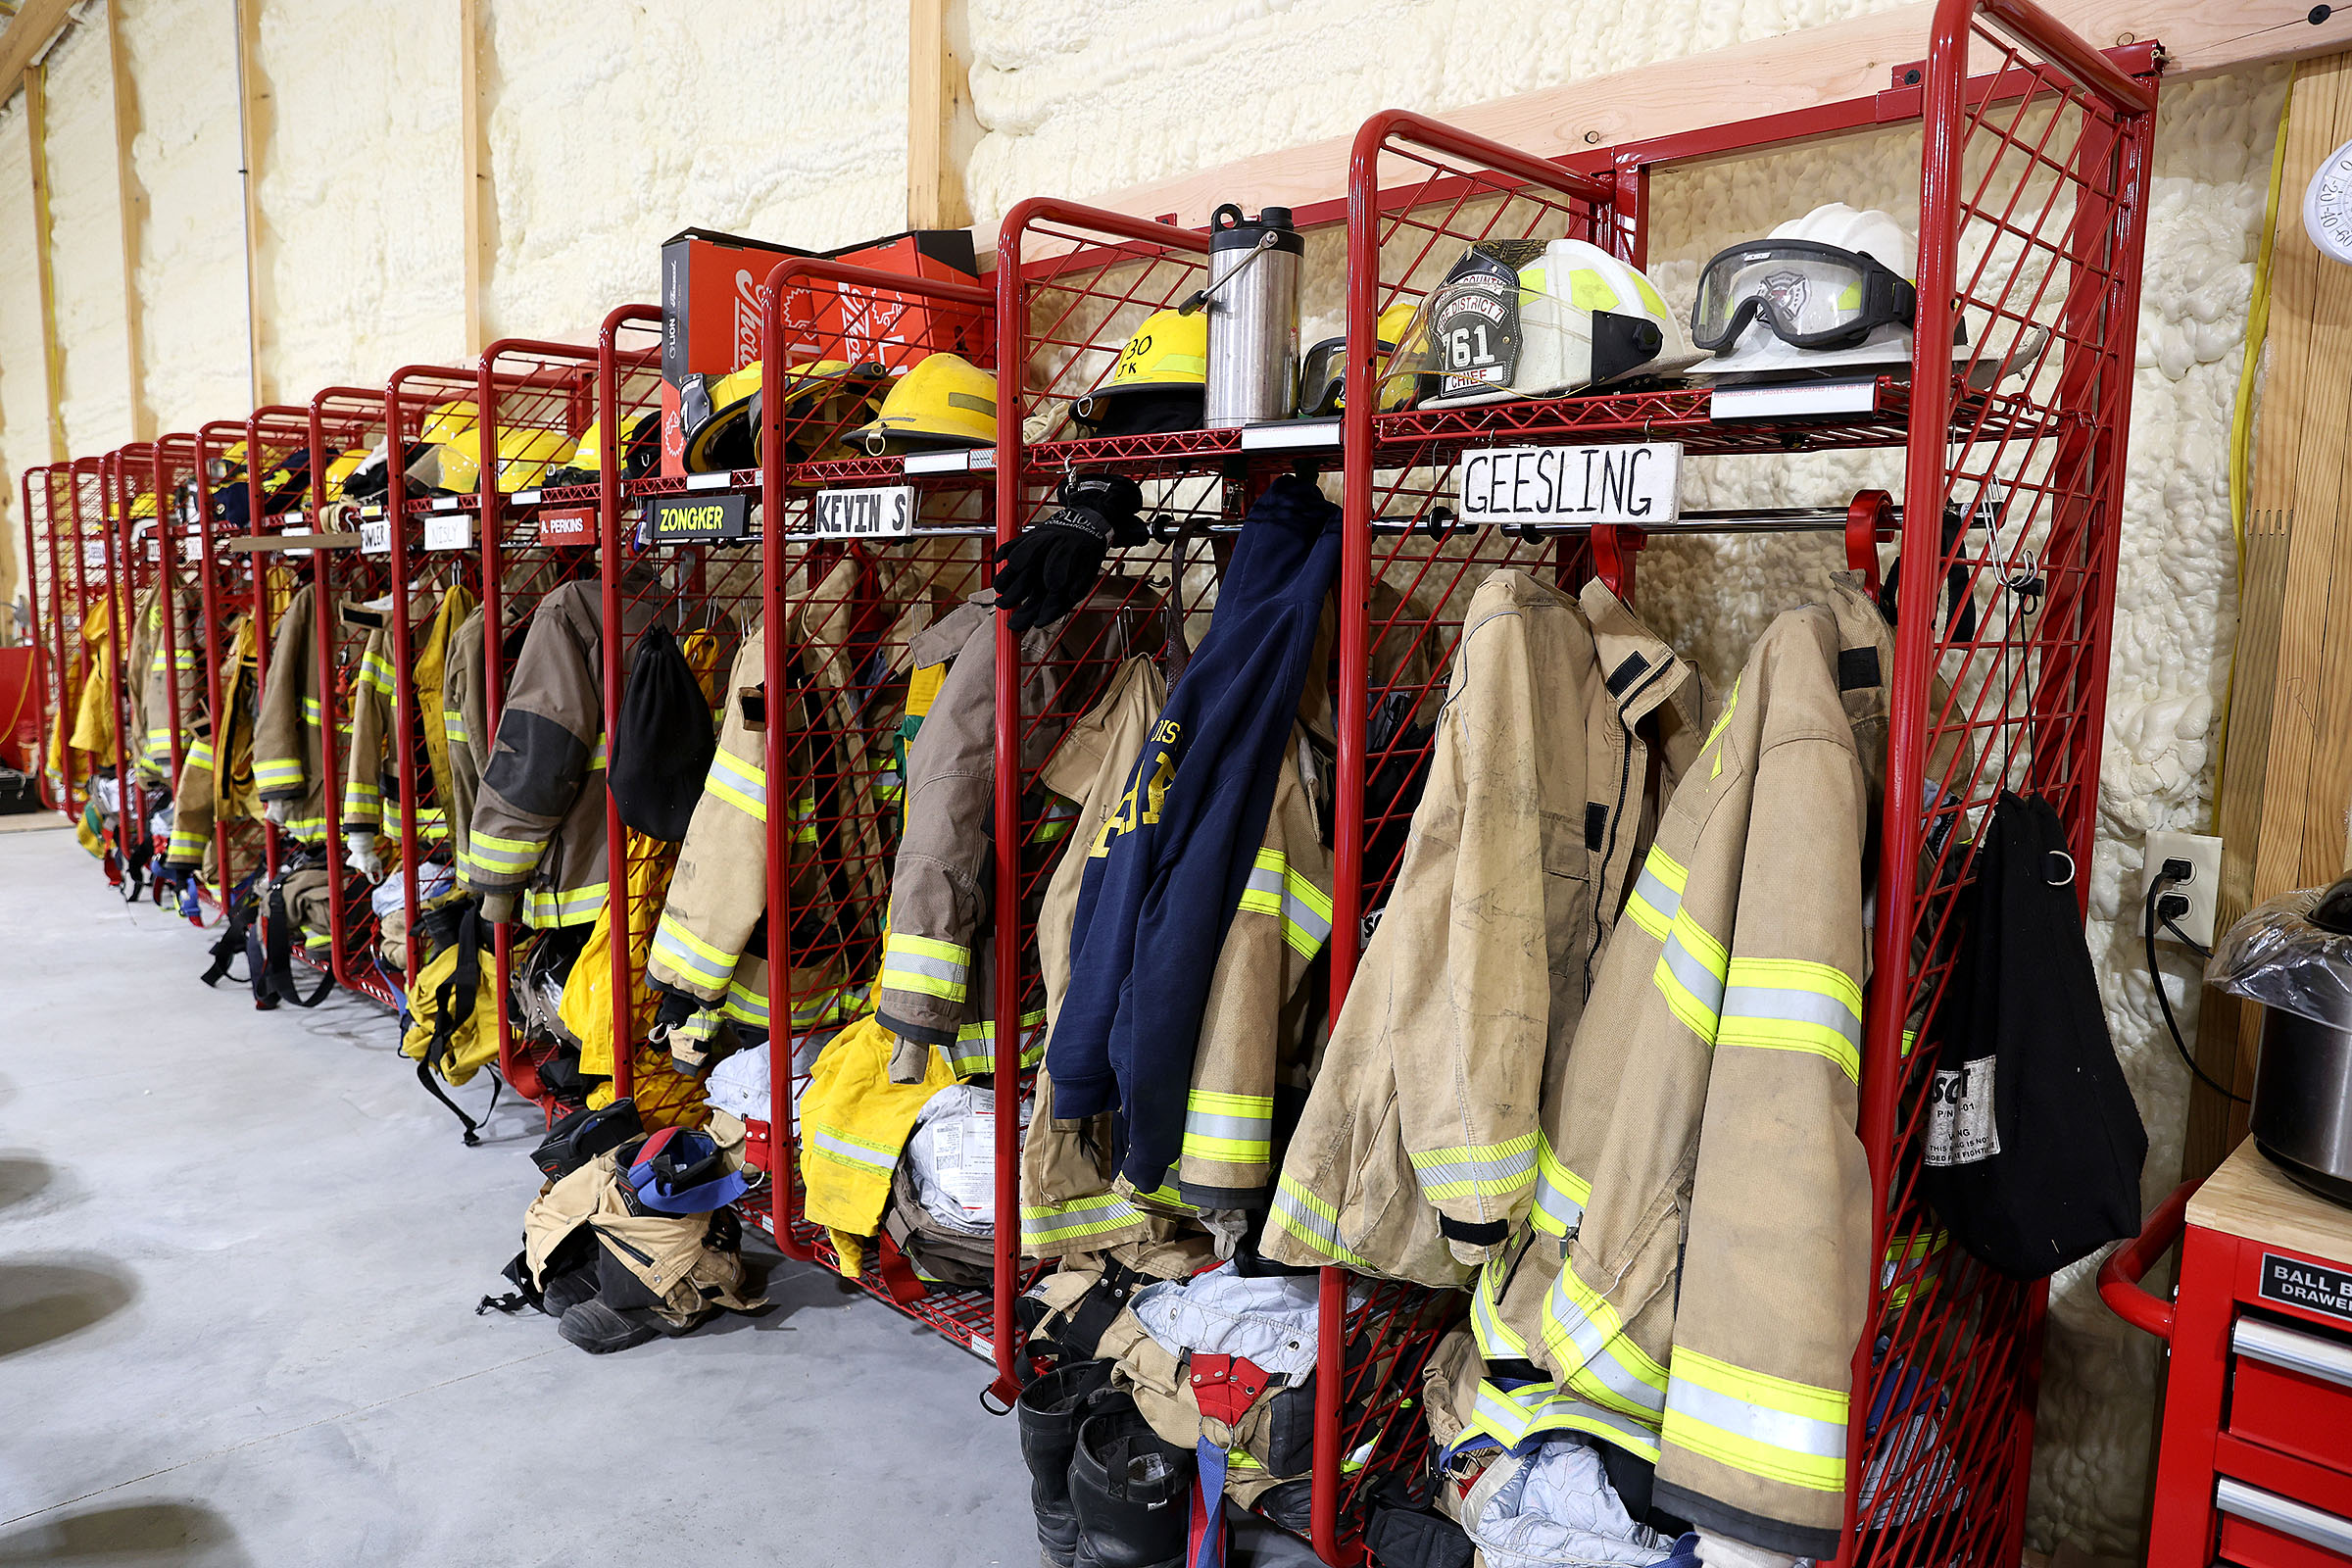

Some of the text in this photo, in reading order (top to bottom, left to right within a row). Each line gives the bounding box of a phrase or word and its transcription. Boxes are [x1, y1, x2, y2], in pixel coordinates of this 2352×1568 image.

[1438, 297, 1504, 332] FIRE DISTRICT 7
[1441, 324, 1495, 370] 761
[1451, 369, 1487, 388] CHIEF
[1464, 448, 1652, 516] GEESLING
[541, 517, 584, 533] A. PERKINS
[660, 506, 724, 532] ZONGKER
[816, 493, 906, 533] KEVIN S
[2274, 1265, 2331, 1292] BALL
